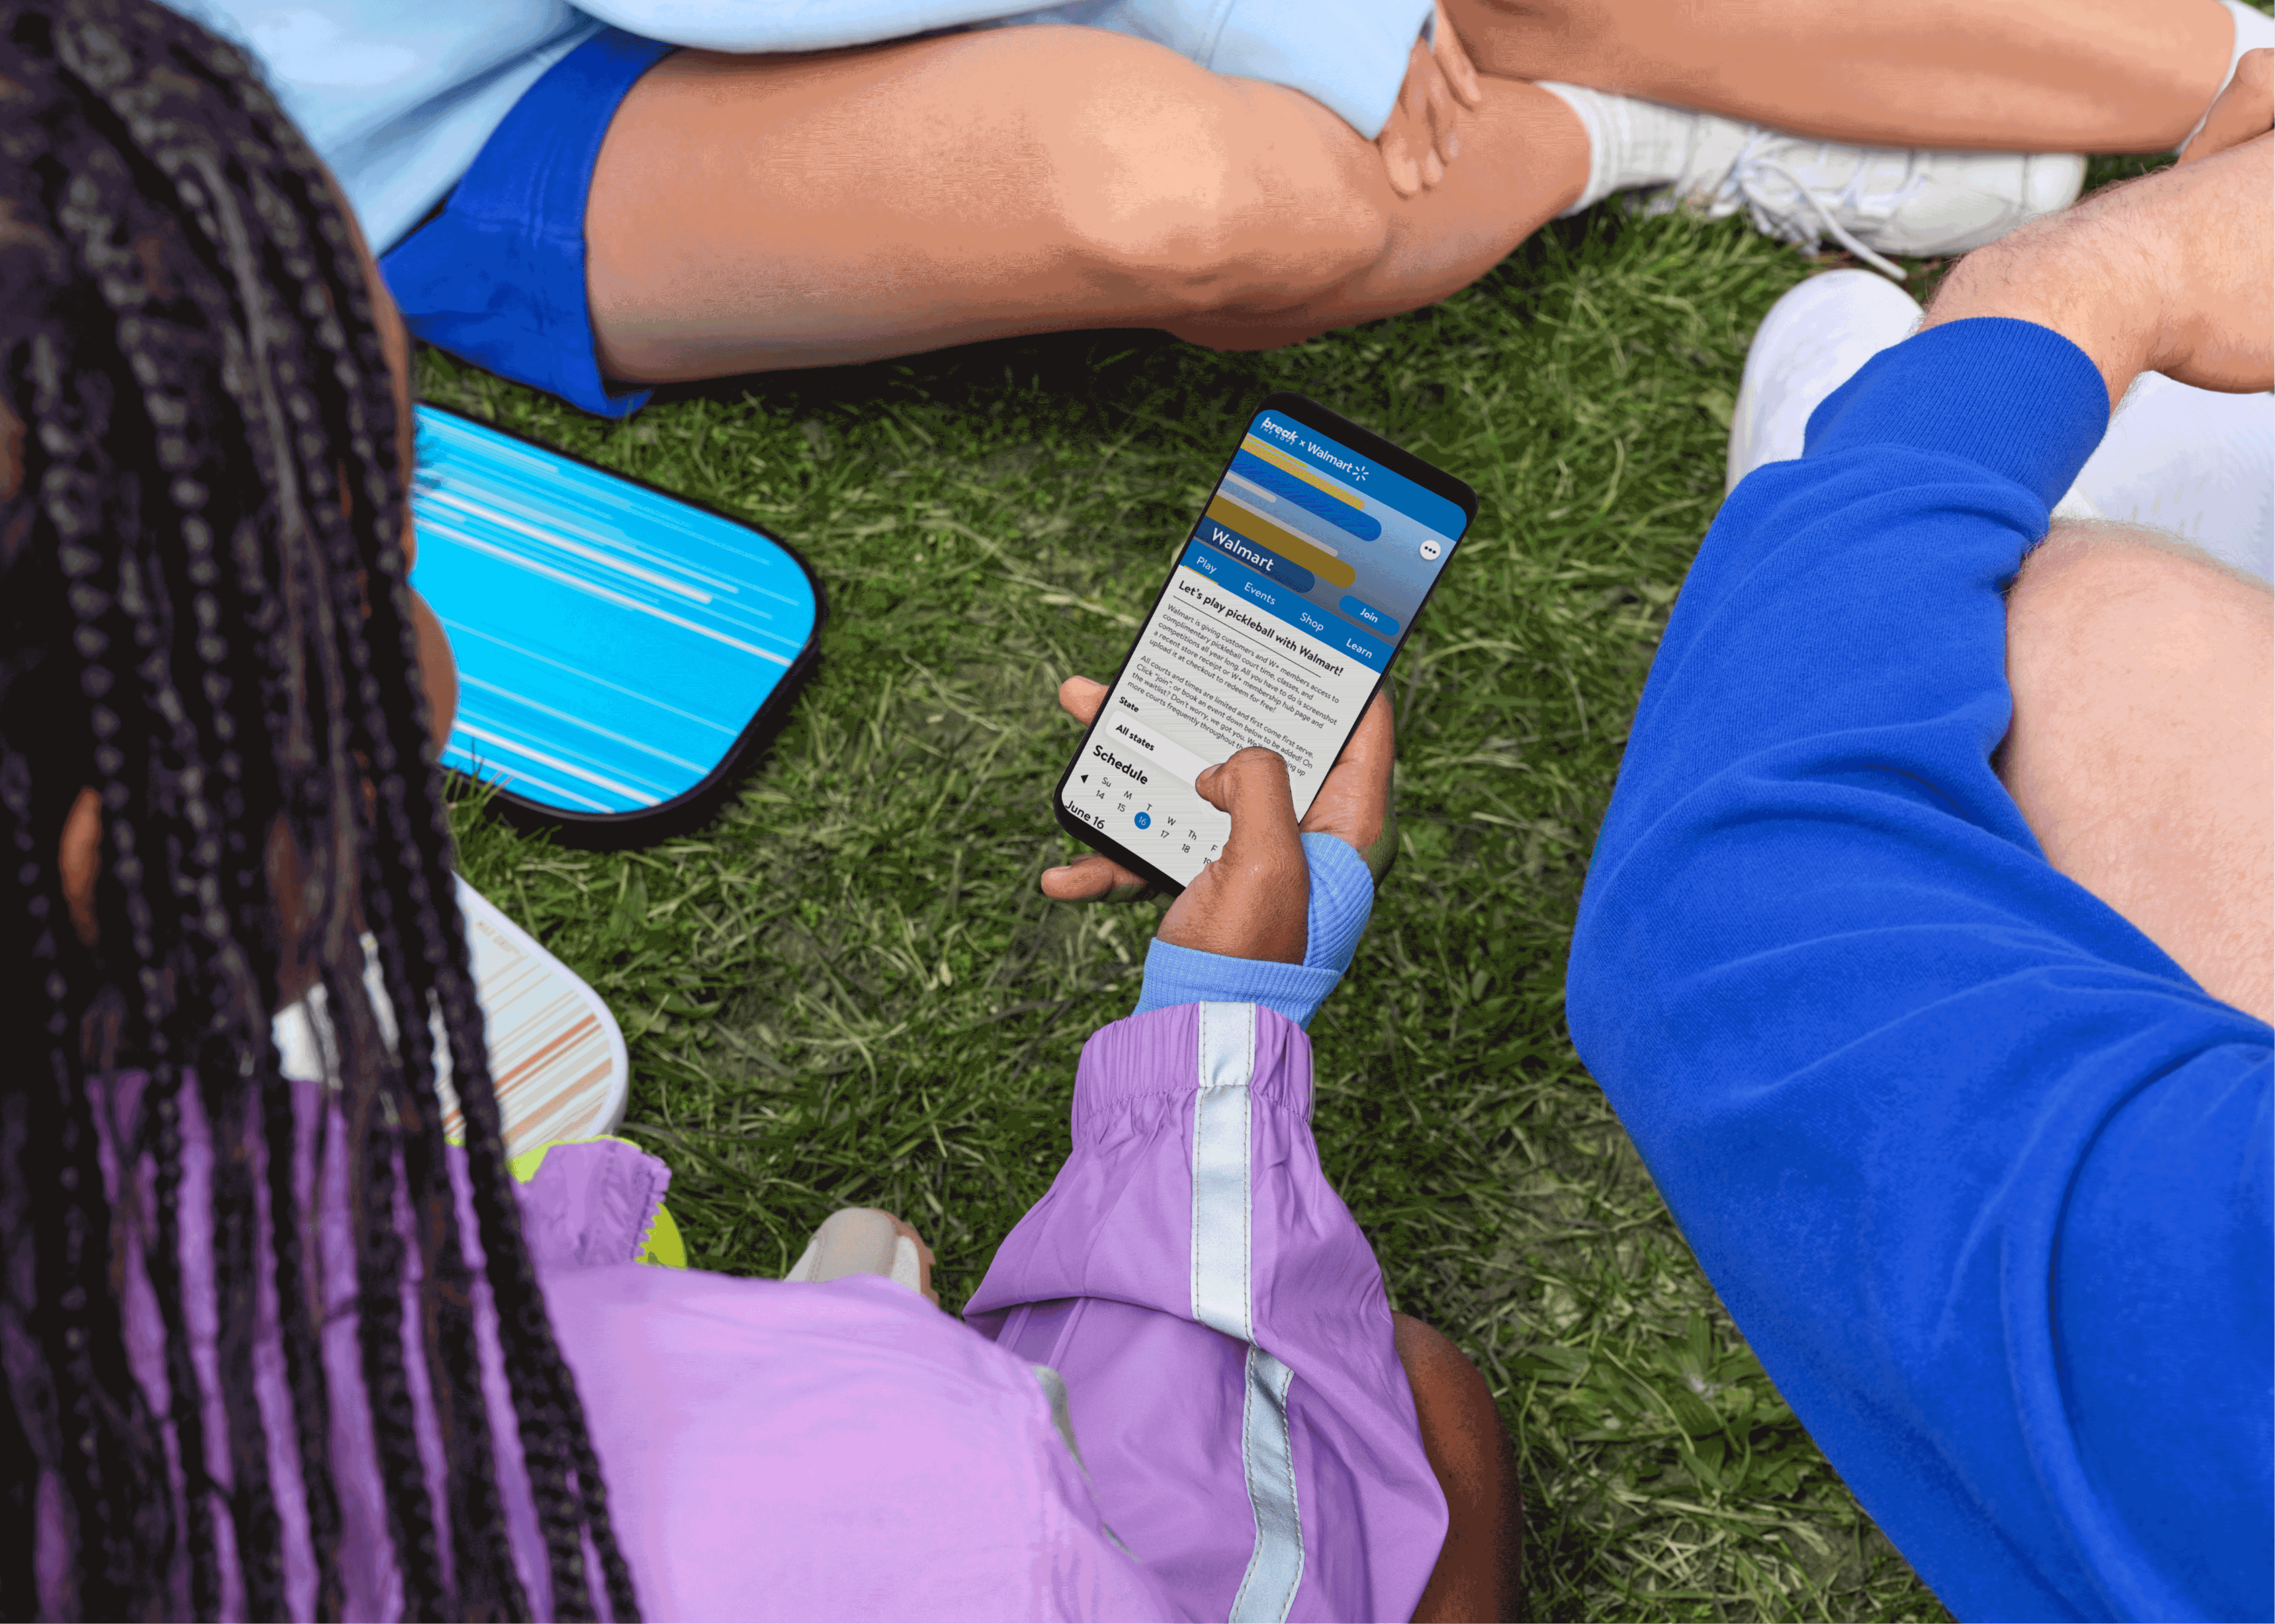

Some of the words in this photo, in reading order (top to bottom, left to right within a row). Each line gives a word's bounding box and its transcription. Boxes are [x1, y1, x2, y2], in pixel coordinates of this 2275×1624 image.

[1260, 425, 1273, 434] THE
[1275, 434, 1294, 445] LOVE
[1261, 417, 1298, 442] break
[1308, 441, 1353, 473] Walmart
[1212, 527, 1274, 571] Walmart
[1196, 556, 1217, 575] Play
[1244, 582, 1276, 605] Events
[1299, 612, 1324, 632] Shop
[1345, 637, 1372, 659] Learn
[1202, 596, 1226, 613] play
[1225, 608, 1275, 638] pickleball
[1275, 635, 1297, 651] with
[1299, 645, 1344, 676] Walmart!
[1360, 608, 1378, 623] Join
[1149, 639, 1172, 654] upload
[1185, 659, 1216, 679] checkout
[1216, 675, 1223, 683] to
[1224, 681, 1249, 698] redeem
[1249, 694, 1260, 703] for
[1260, 699, 1277, 713] free!
[1158, 622, 1200, 649] competitions
[1209, 650, 1224, 661] year
[1224, 657, 1239, 671] long.
[1240, 667, 1251, 676] All
[1249, 673, 1263, 683] you
[1263, 679, 1279, 692] have
[1287, 694, 1296, 702] do
[1302, 702, 1337, 726] screenshot
[1158, 634, 1181, 649] recent
[1181, 646, 1199, 658] store
[1199, 655, 1222, 672] receipt
[1231, 672, 1242, 681] W+
[1242, 680, 1281, 705] membership
[1281, 701, 1294, 712] hub
[1294, 710, 1311, 721] page
[1310, 719, 1324, 729] and
[1162, 614, 1211, 644] complimentary
[1210, 640, 1242, 660] pickleball
[1241, 657, 1260, 670] court
[1260, 666, 1275, 681] time,
[1276, 677, 1299, 694] classes,
[1300, 691, 1314, 700] and
[1168, 603, 1194, 623] Walmart
[1200, 624, 1221, 639] giving
[1221, 635, 1255, 656] customers
[1255, 654, 1268, 663] and
[1268, 659, 1279, 669] W+
[1280, 667, 1310, 687] members
[1310, 684, 1331, 699] access
[1331, 695, 1340, 704] to
[1119, 696, 1139, 712] State
[1127, 681, 1145, 694] more
[1145, 692, 1166, 707] courts
[1167, 702, 1200, 726] frequently
[1200, 722, 1235, 747] throughout
[1132, 672, 1143, 682] the
[1144, 680, 1171, 697] waitlist?
[1189, 705, 1209, 721] worry,
[1210, 717, 1220, 726] we
[1220, 724, 1232, 733] got
[1231, 730, 1245, 742] you.
[1297, 768, 1305, 776] up
[1136, 663, 1153, 677] Click
[1181, 688, 1198, 702] book
[1207, 705, 1226, 718] event
[1226, 715, 1244, 728] down
[1244, 724, 1263, 739] below
[1263, 736, 1271, 744] to
[1271, 740, 1280, 750] be
[1280, 747, 1303, 762] added!
[1302, 759, 1313, 769] On
[1140, 655, 1151, 664] All
[1150, 662, 1171, 676] courts
[1171, 673, 1185, 683] and
[1184, 679, 1202, 694] times
[1203, 691, 1214, 700] are
[1214, 696, 1237, 713] limited
[1236, 711, 1250, 720] and
[1249, 716, 1263, 728] first
[1263, 726, 1281, 739] come
[1281, 735, 1296, 747] first
[1295, 744, 1313, 759] serve.
[1092, 744, 1148, 785] Schedule
[1115, 724, 1129, 736] All
[1129, 733, 1155, 751] states
[1063, 800, 1091, 821] June
[1092, 816, 1105, 829] 16
[1095, 789, 1105, 800] 14
[1117, 803, 1126, 813] 15
[1138, 816, 1146, 826] 16
[1160, 830, 1169, 839] 17
[1181, 843, 1190, 853] 18
[1101, 776, 1111, 787] Su
[1123, 790, 1132, 800] M
[1167, 816, 1177, 826] W
[1188, 829, 1197, 840] Th
